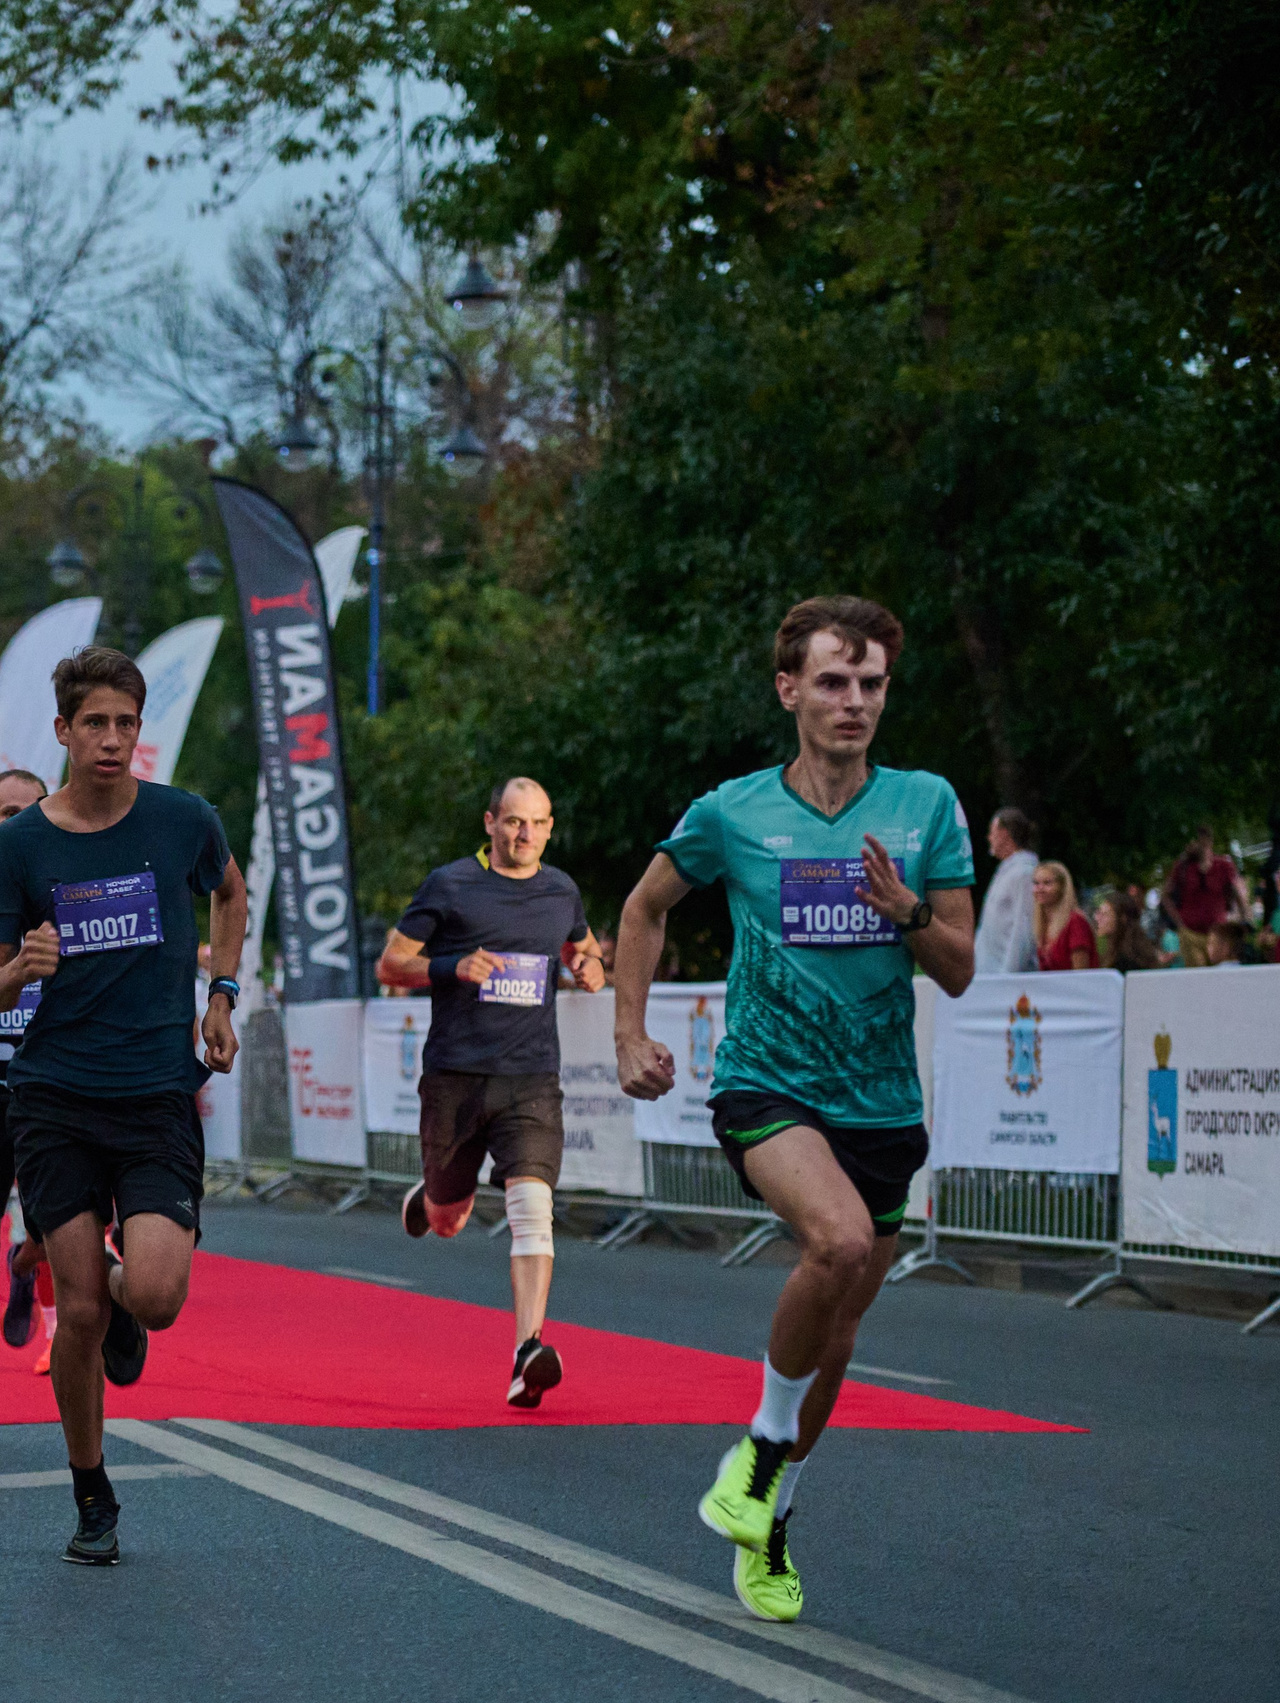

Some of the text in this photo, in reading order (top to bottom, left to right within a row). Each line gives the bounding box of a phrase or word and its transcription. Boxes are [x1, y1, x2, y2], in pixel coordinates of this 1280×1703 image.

[106, 876, 140, 889] НОЧНОЙ
[106, 885, 134, 895] ЗАБЕГ
[79, 913, 138, 943] 10017
[802, 904, 881, 932] 10089
[494, 978, 537, 998] 10022
[1185, 1068, 1280, 1098] АДМИНИСТРАЦИЯ
[1185, 1110, 1252, 1139] ГОРОДСКОГО
[1184, 1151, 1225, 1175] САМАРА
